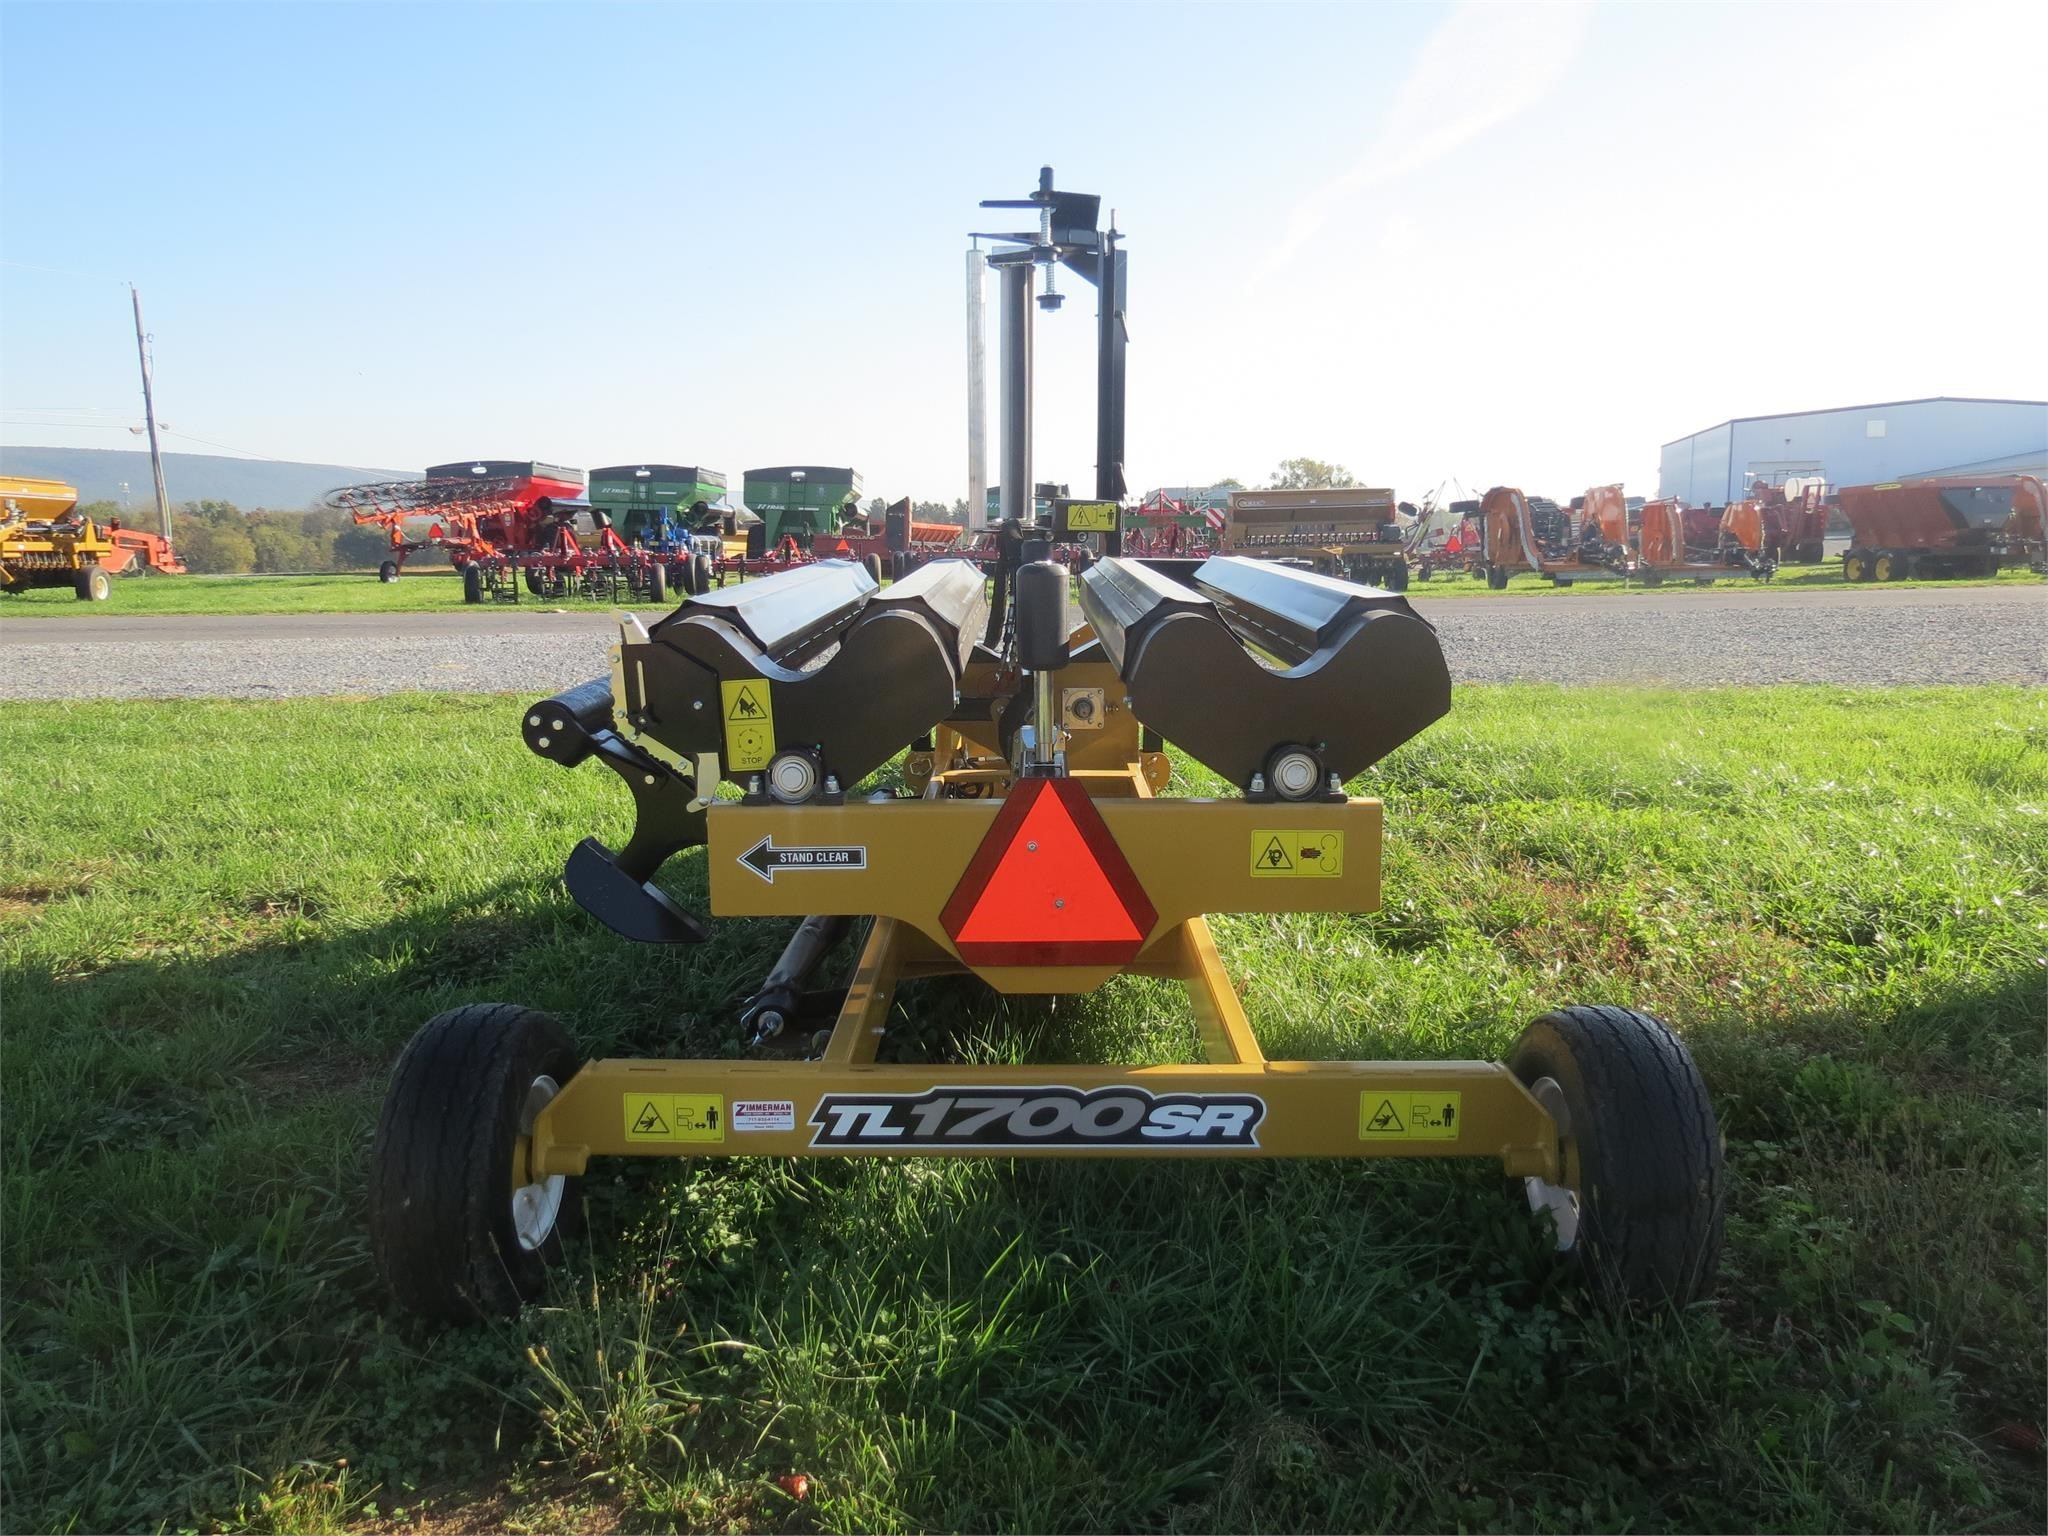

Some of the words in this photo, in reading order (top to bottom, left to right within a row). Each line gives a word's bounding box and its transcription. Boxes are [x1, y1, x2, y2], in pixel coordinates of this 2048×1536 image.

[741, 756, 763, 764] STOP
[780, 852, 814, 863] STAND
[816, 852, 849, 863] CLEAR
[736, 1103, 792, 1116] ZIMMERMAN
[828, 1096, 1255, 1138] TL1700SR
